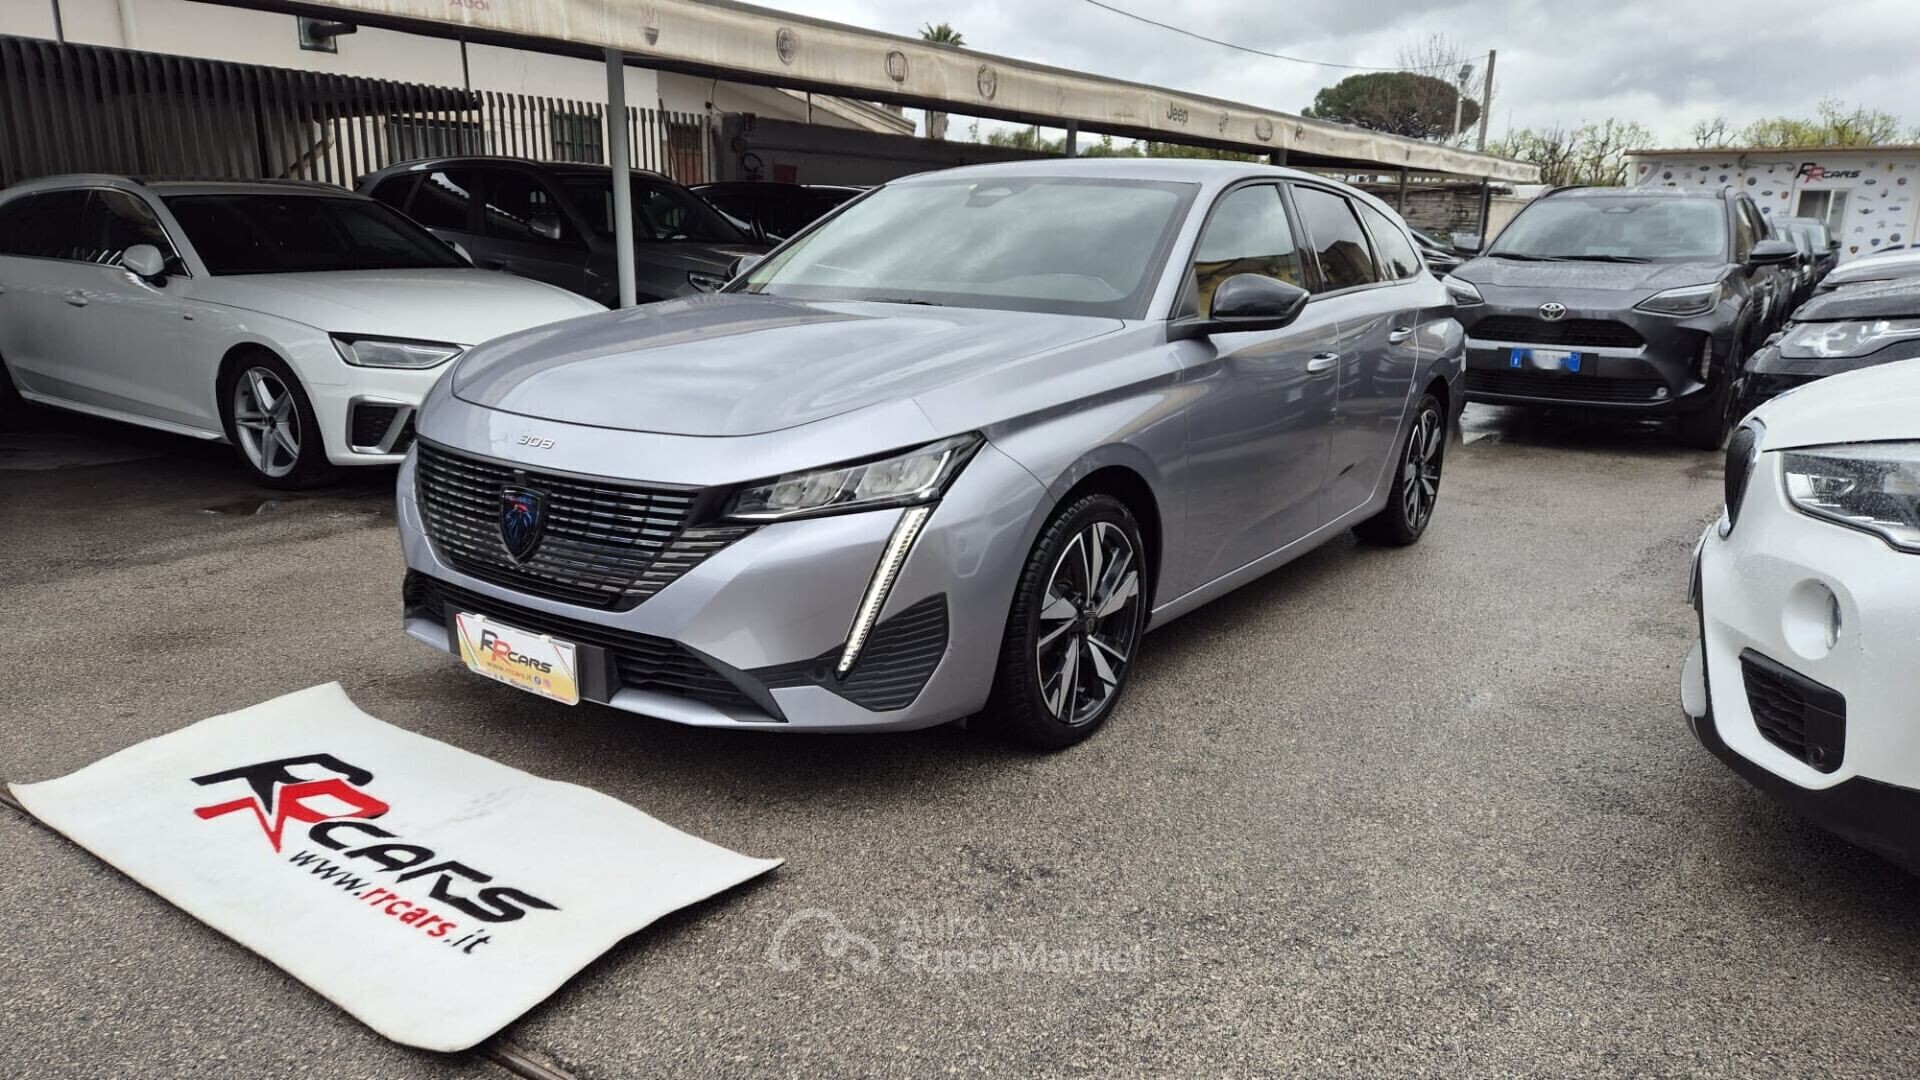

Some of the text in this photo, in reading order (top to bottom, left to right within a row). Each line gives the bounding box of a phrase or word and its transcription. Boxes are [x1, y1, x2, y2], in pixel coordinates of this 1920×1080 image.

[1167, 102, 1188, 126] Jeep
[517, 435, 555, 449] 308
[289, 850, 493, 954] www.rrcars.it
